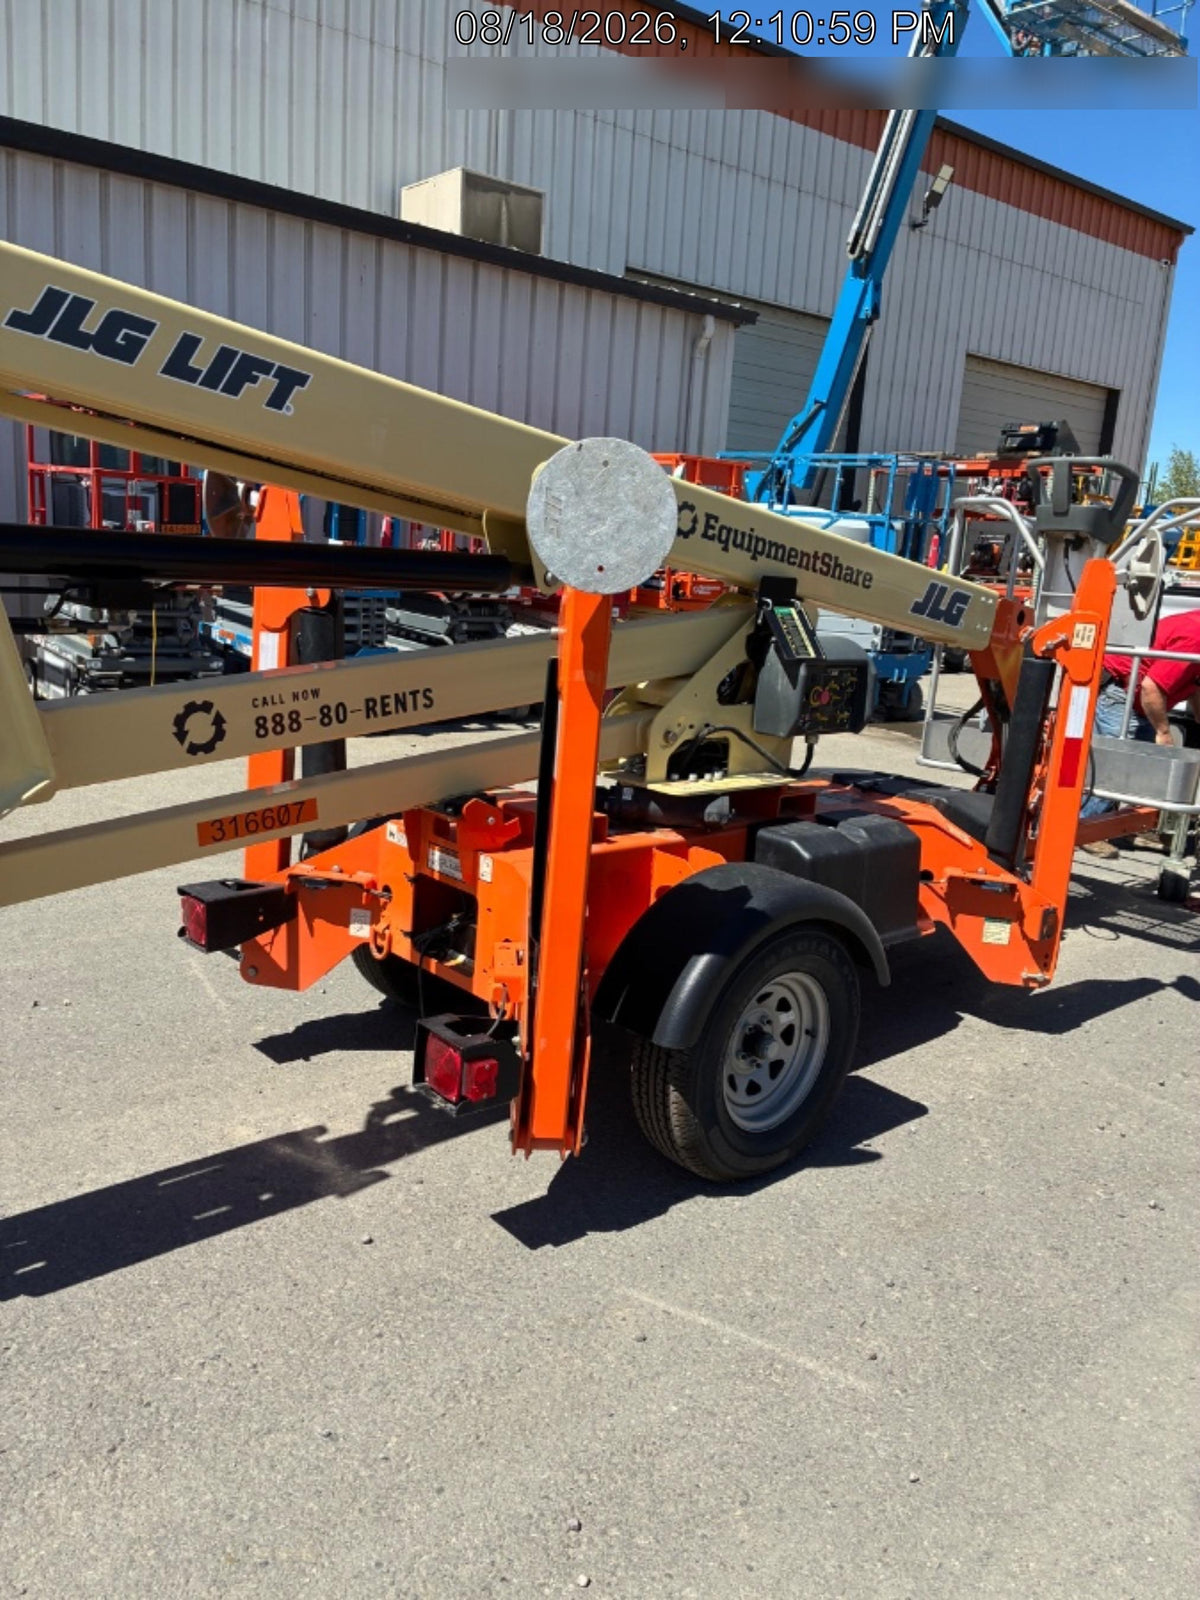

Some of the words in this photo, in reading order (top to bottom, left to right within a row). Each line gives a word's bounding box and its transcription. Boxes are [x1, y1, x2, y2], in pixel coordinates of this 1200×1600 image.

[2, 285, 159, 366] JLG
[157, 330, 313, 414] LIFT
[701, 513, 873, 589] EquipmentShare
[910, 581, 972, 627] JLG
[251, 692, 286, 708] CALL
[292, 687, 321, 702] NOW
[254, 687, 435, 739] 888-80-RENTS
[210, 800, 306, 843] 316607
